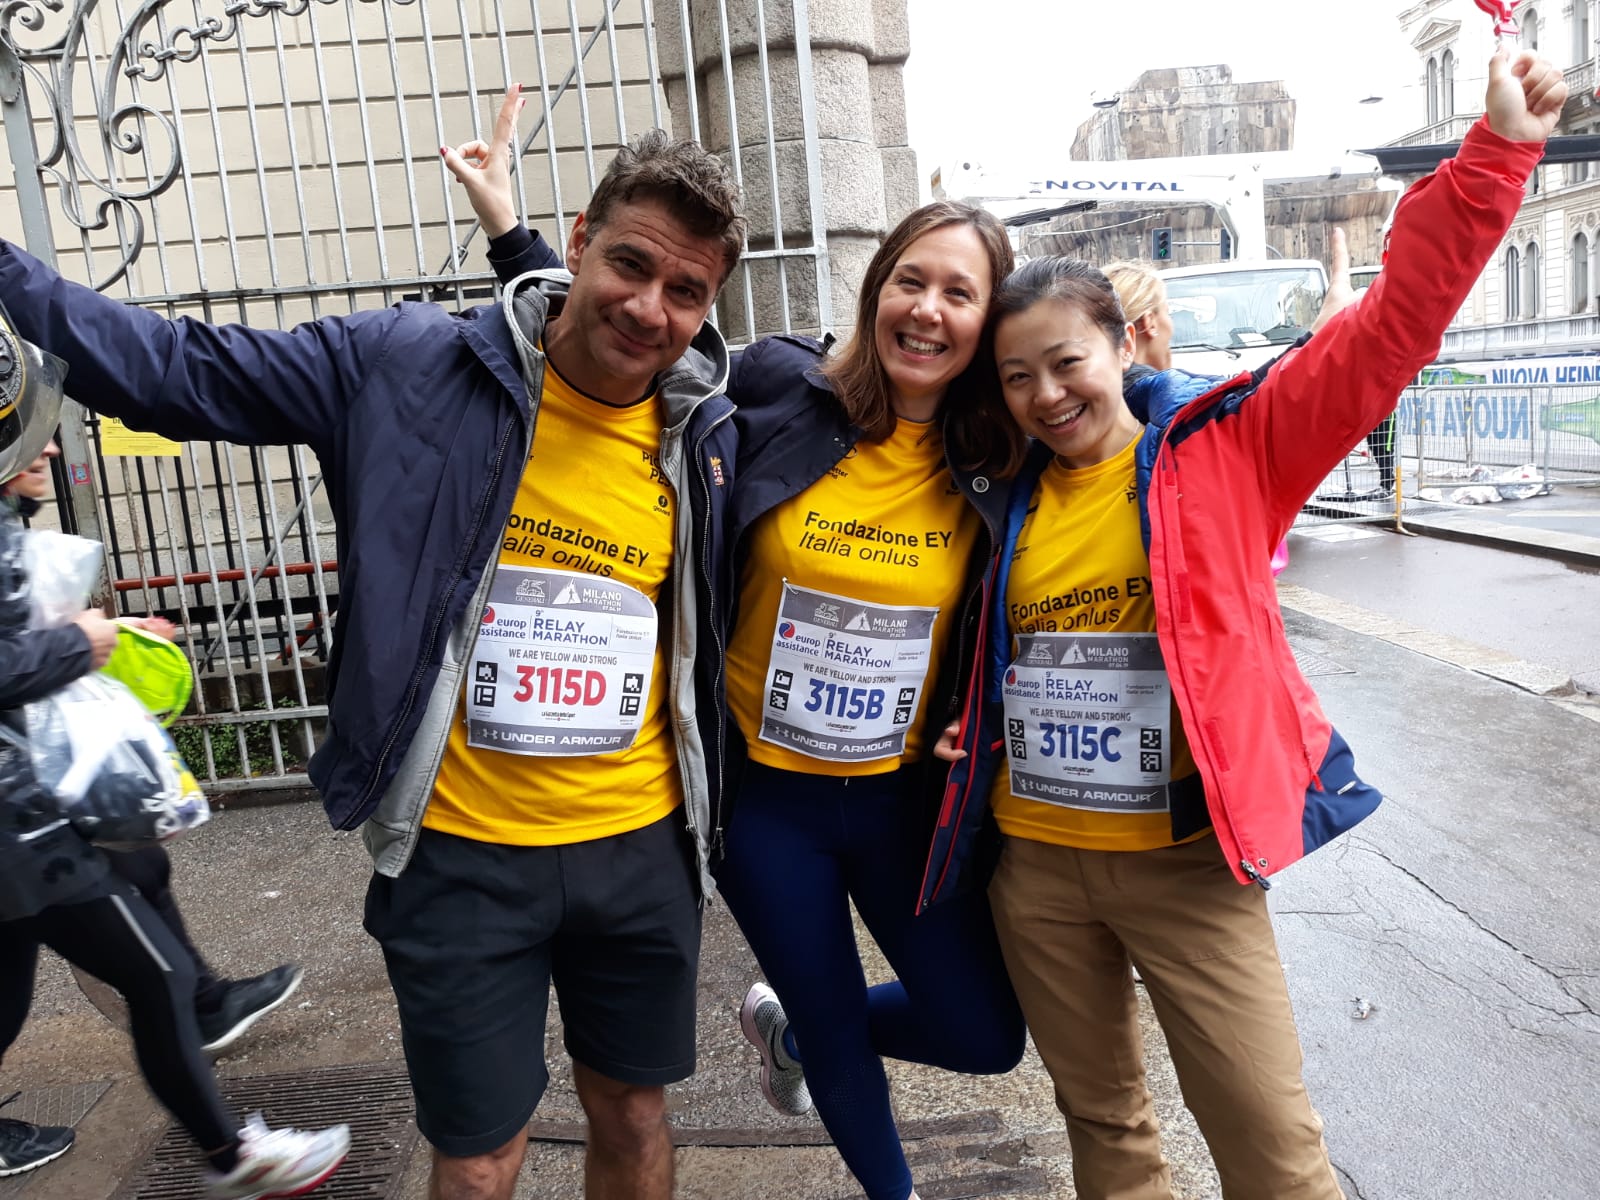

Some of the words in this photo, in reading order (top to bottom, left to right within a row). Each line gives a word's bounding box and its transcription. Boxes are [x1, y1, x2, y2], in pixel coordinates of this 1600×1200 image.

[805, 511, 918, 547] Fondazione
[925, 531, 952, 548] EY
[508, 513, 619, 557] ondazione
[623, 545, 649, 568] EY
[502, 535, 546, 558] alia
[552, 550, 614, 577] onlus
[799, 531, 851, 557] Italia
[859, 547, 919, 567] onlus
[582, 597, 621, 607] MARATHON
[583, 588, 622, 600] MILANO
[1011, 585, 1119, 623] Fondazione
[497, 619, 527, 630] europ
[534, 618, 585, 633] RELAY
[873, 618, 907, 628] MILANO
[1063, 607, 1121, 630] onlus
[480, 627, 526, 639] ssistance
[532, 630, 608, 645] MARATHON
[872, 626, 906, 634] MARATHON
[776, 639, 819, 657] assistance
[795, 634, 821, 647] europ
[826, 639, 873, 657] RELAY
[509, 648, 521, 658] WE
[523, 650, 538, 660] ARE
[540, 651, 571, 662] YELLOW
[572, 655, 588, 664] AND
[589, 655, 618, 666] STRONG
[1088, 647, 1129, 656] MILANO
[824, 652, 892, 669] MARATHON
[803, 662, 813, 672] WE
[813, 664, 828, 675] ARE
[830, 669, 857, 682] YELLOW
[858, 676, 872, 684] AND
[872, 676, 897, 684] STRONG
[513, 664, 607, 706] 3115D
[1017, 680, 1040, 690] europ
[1046, 678, 1093, 691] RELAY
[804, 678, 885, 720] 3115B
[1005, 687, 1040, 699] assistance
[1046, 690, 1118, 703] MARATHON
[1029, 707, 1039, 716] WE
[1040, 708, 1054, 717] ARE
[1055, 709, 1083, 719] YELLOW
[1085, 712, 1100, 720] AND
[1101, 712, 1131, 721] STRONG
[501, 731, 556, 745] UNDER
[560, 735, 621, 745] ARMOUR
[791, 731, 837, 751] UNDER
[840, 740, 892, 753] ARMOUR
[1039, 722, 1122, 763] 3115C
[1036, 782, 1079, 798] UNDER
[1083, 790, 1151, 802] ARMOUR
